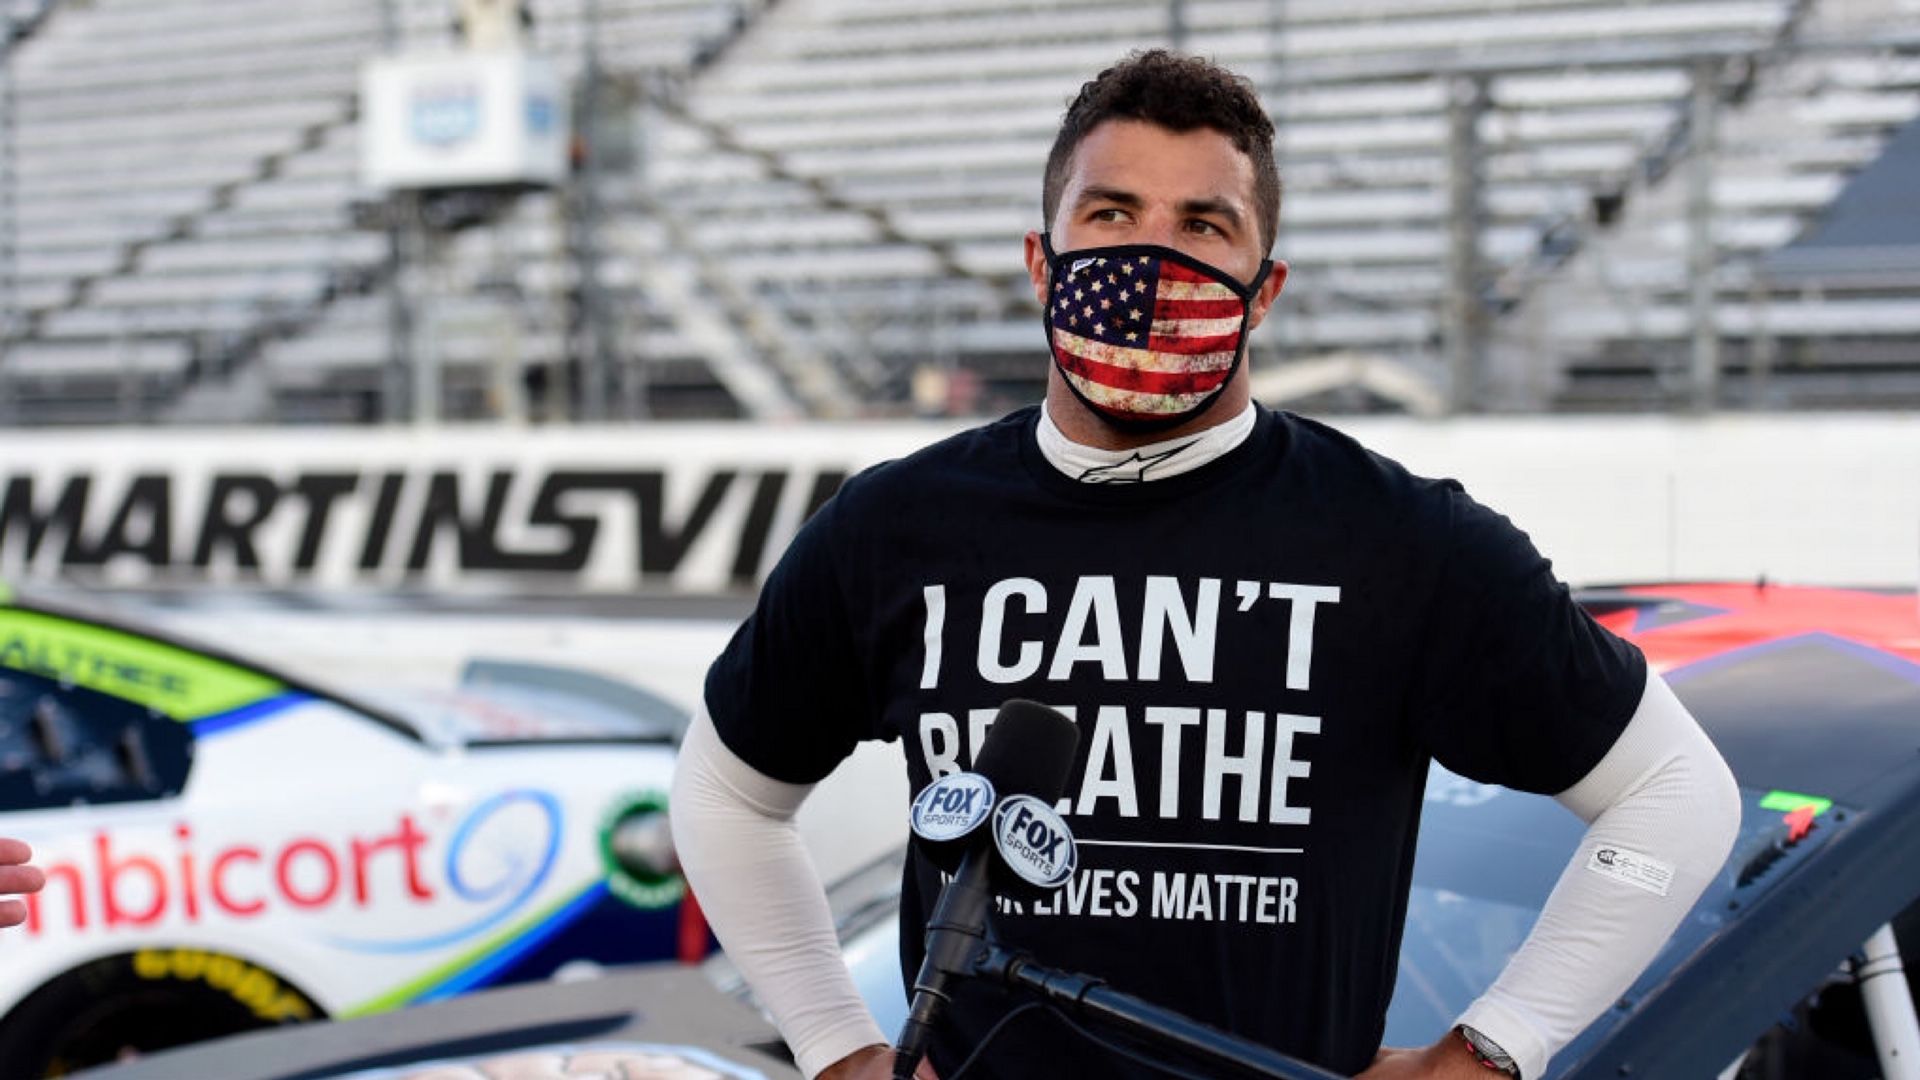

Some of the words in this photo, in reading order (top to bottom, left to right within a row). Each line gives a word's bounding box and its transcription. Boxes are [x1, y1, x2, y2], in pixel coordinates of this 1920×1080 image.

[920, 584, 946, 689] I
[976, 575, 1341, 691] CAN'T
[922, 814, 971, 827] SPORTS
[927, 787, 982, 814] FOX
[1004, 834, 1054, 877] SPORTS
[1010, 805, 1066, 865] FOX
[1151, 872, 1299, 924] MATTER
